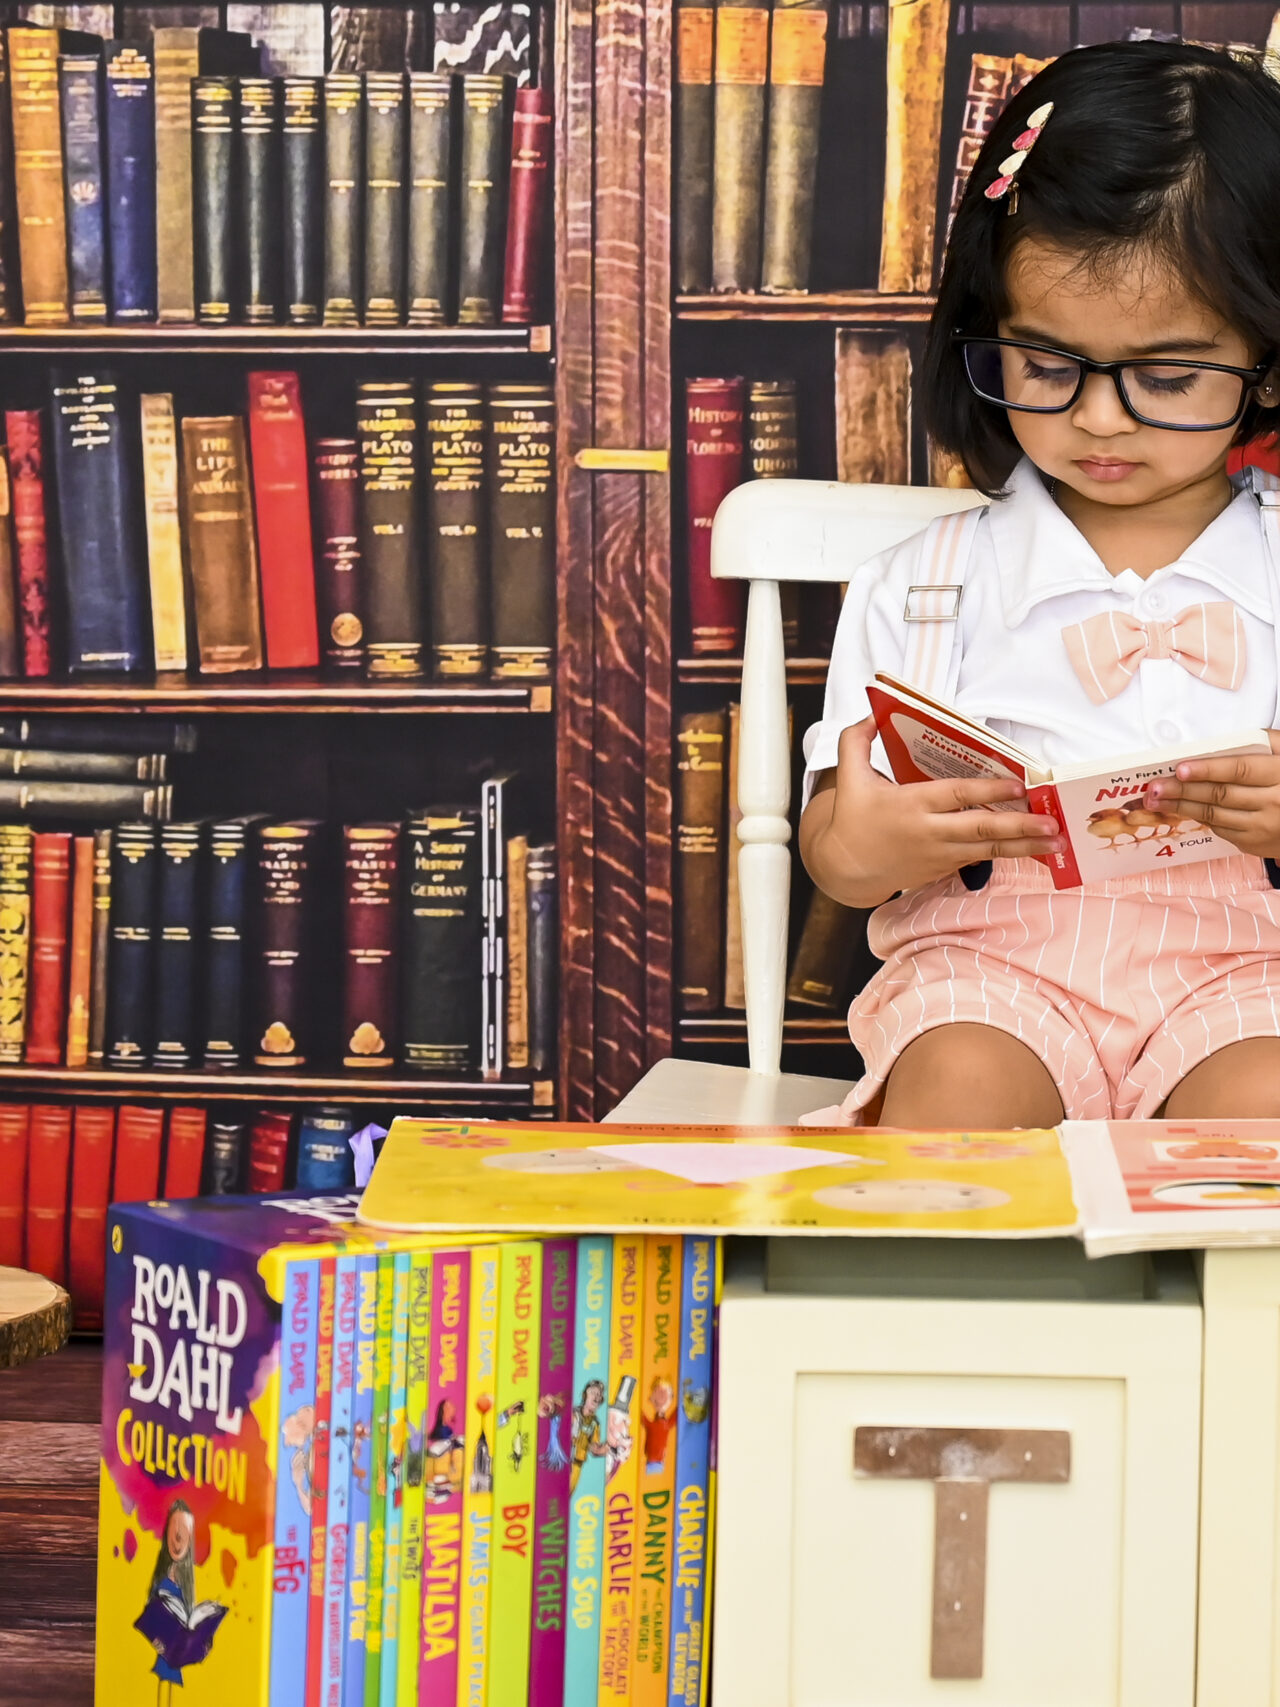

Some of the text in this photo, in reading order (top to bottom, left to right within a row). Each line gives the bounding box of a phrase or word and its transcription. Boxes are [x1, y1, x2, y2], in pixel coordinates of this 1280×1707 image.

[362, 441, 413, 454] PLATO
[432, 441, 483, 454] PLATO
[499, 443, 550, 456] PLATO
[1111, 776, 1130, 785] My
[1136, 768, 1162, 779] First
[414, 841, 423, 853] A
[1155, 837, 1213, 857] 4 FOUR
[131, 1255, 248, 1349] ROALD
[130, 1322, 243, 1435] DAHL
[116, 1408, 248, 1505] COLLECTION
[468, 1511, 492, 1587] JAMES
[502, 1503, 530, 1558] BOY
[571, 1494, 599, 1629] GOING SOLO
[608, 1492, 633, 1595] CHARLIE
[641, 1489, 670, 1584] DANNY
[676, 1484, 705, 1589] CHARLIE
[274, 1546, 306, 1594] BFG
[423, 1512, 461, 1662] MATILDA
[536, 1518, 565, 1631] WITCHES
[468, 1661, 484, 1707] PEAC
